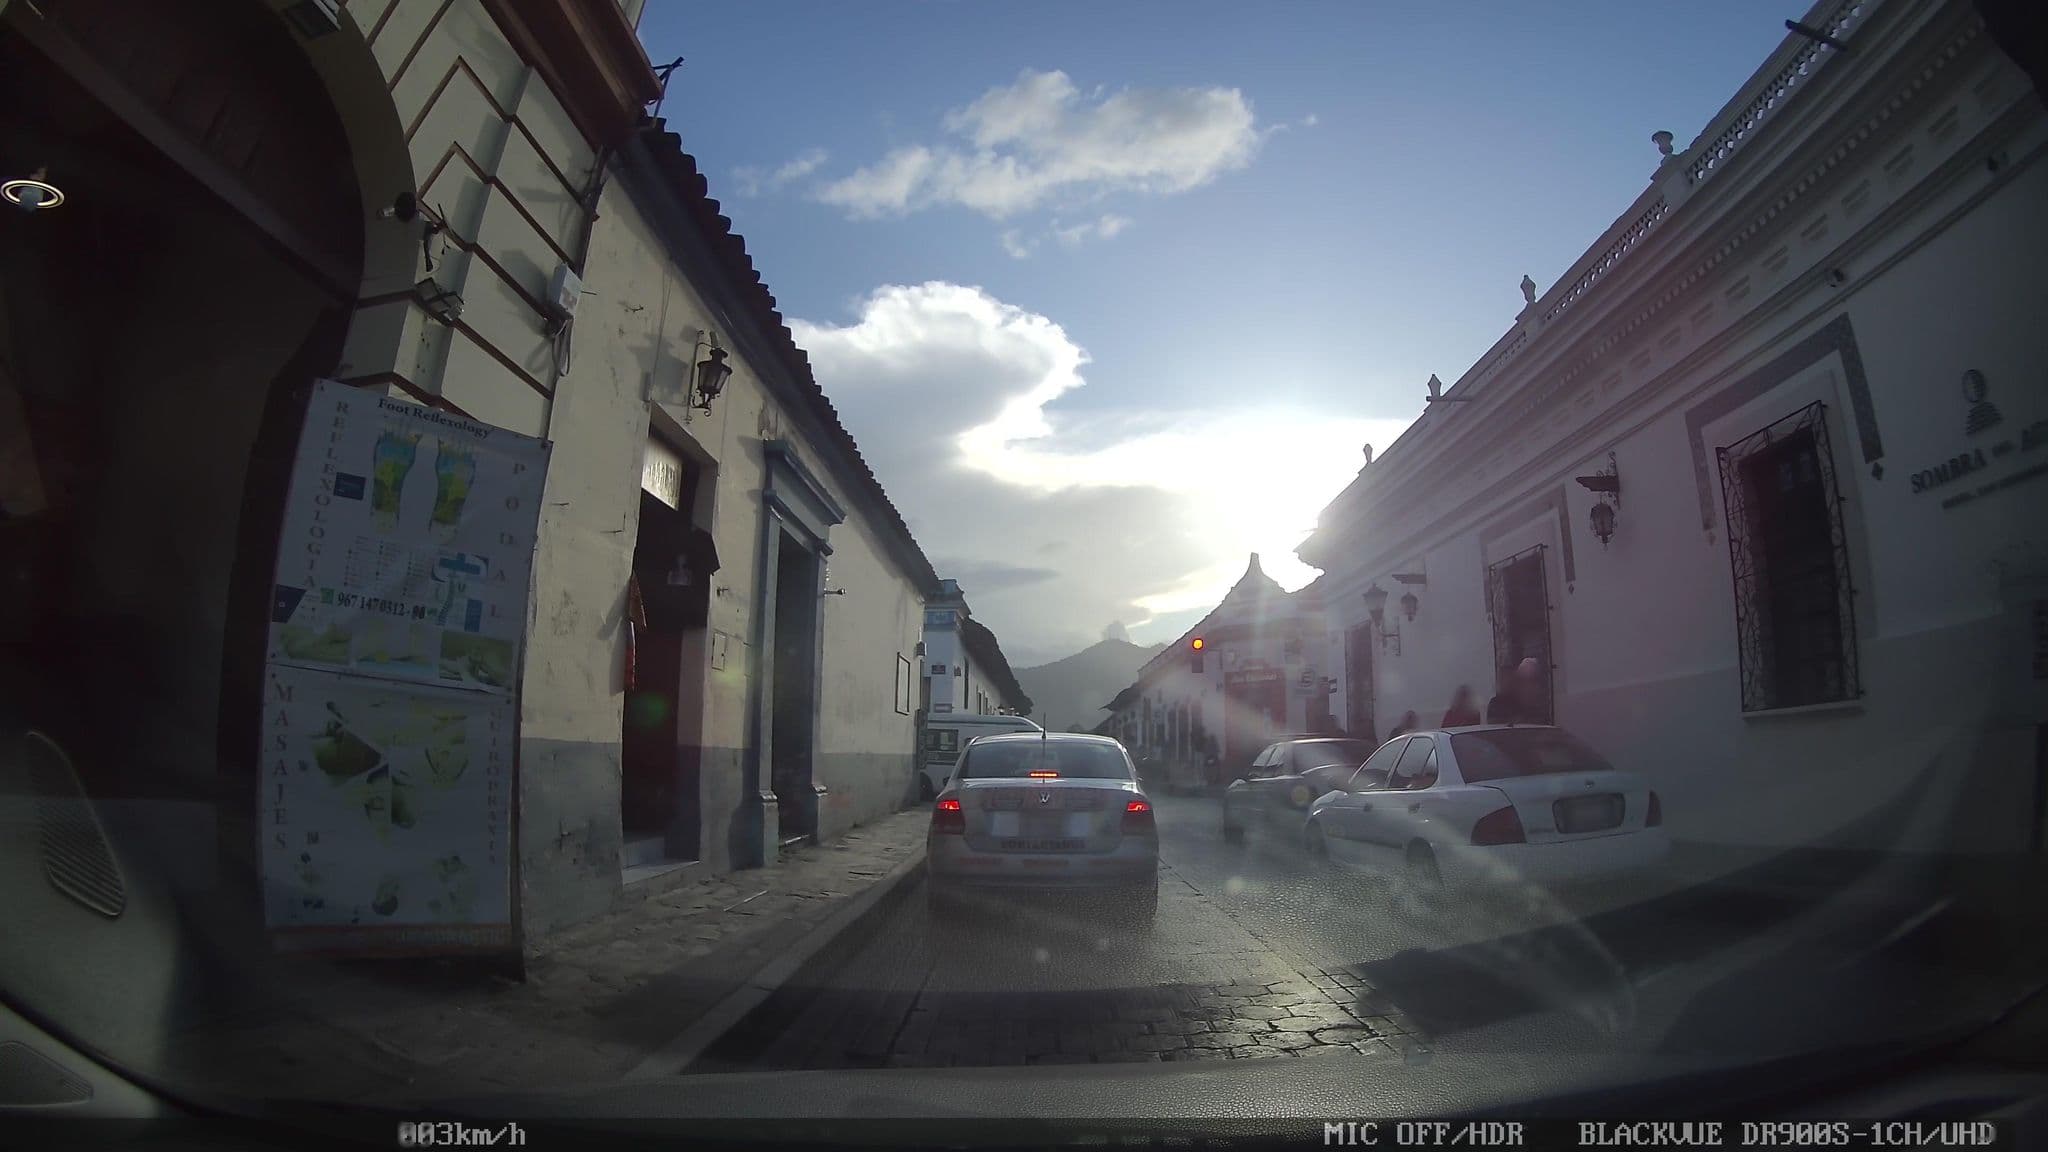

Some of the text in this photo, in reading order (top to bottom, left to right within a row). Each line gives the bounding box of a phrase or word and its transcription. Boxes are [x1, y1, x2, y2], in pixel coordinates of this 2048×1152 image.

[377, 398, 490, 439] Foot Reflexology
[1911, 448, 1987, 493] SOMBRA
[274, 684, 294, 849] MASAJES
